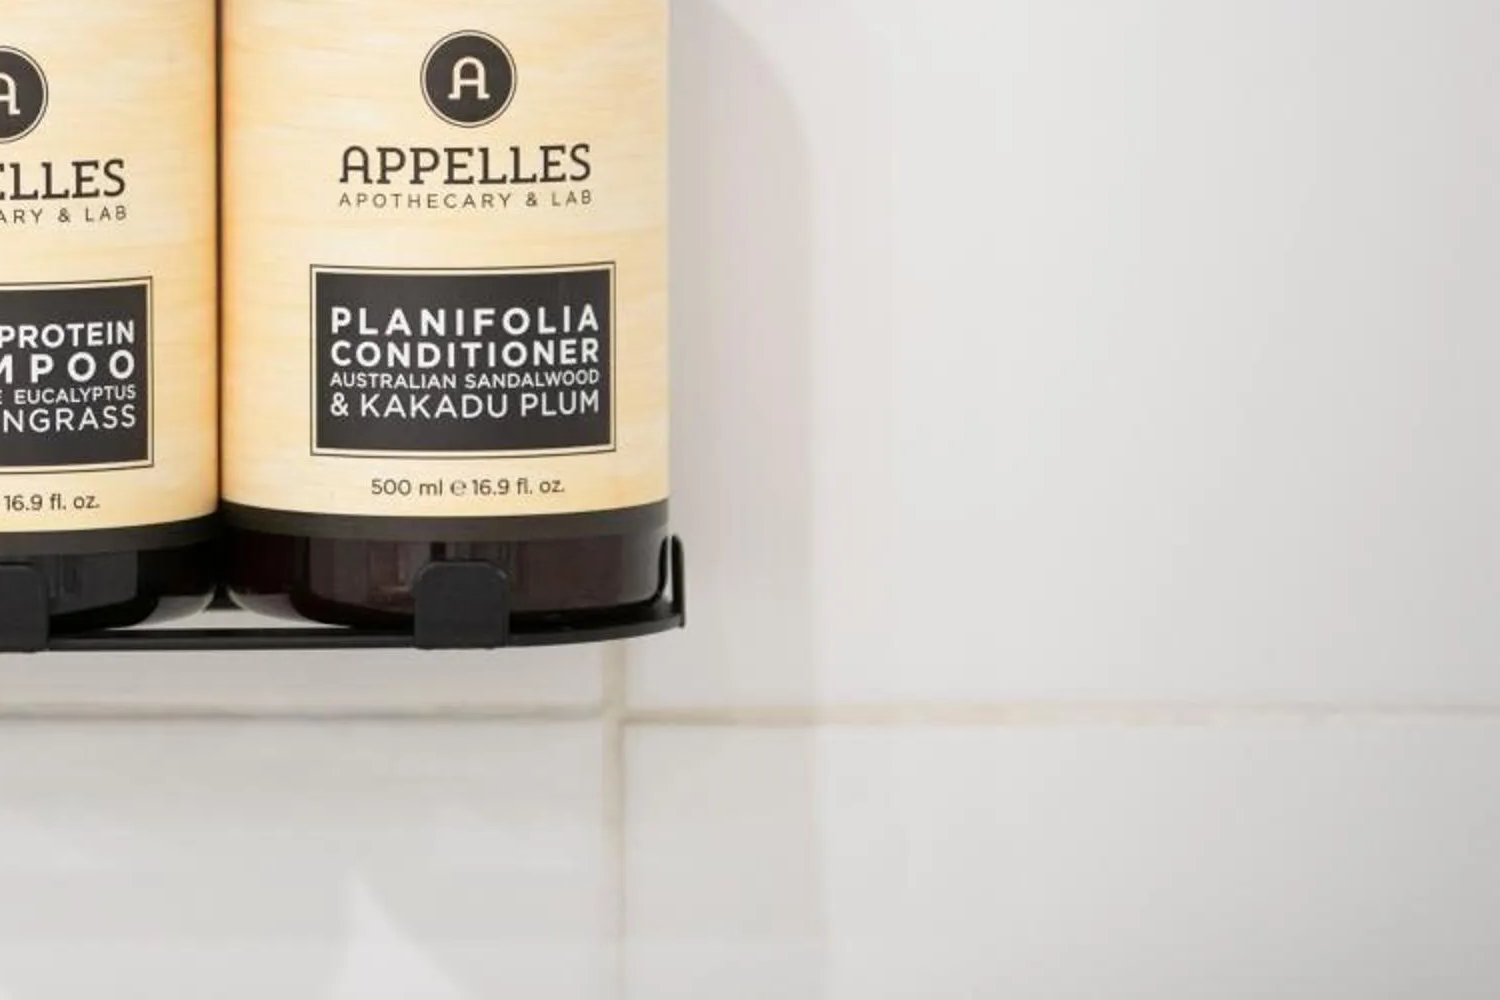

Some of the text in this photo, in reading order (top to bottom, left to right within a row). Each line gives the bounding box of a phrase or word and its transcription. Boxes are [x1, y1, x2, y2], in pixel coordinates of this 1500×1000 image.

[447, 56, 491, 100] A
[339, 142, 591, 185] APPELLES
[339, 188, 592, 210] APOTHECARY & LAB
[57, 207, 71, 223] &
[84, 204, 127, 223] LAB
[331, 303, 599, 337] PLANIFOLIA
[330, 337, 599, 369] CONDITIONER
[329, 367, 600, 390] AUSTRALIAN SANDALWOOD
[13, 383, 137, 405] EUCALYPTUS
[330, 389, 599, 419] & KAKADU PLUM
[371, 478, 413, 497] 500
[418, 478, 443, 497] ml
[471, 478, 511, 497] 16.9
[516, 477, 533, 496] fl.
[539, 479, 565, 494] oz.
[3, 493, 43, 512] 16.9
[49, 492, 67, 511] fl.
[72, 495, 101, 510] oz.
